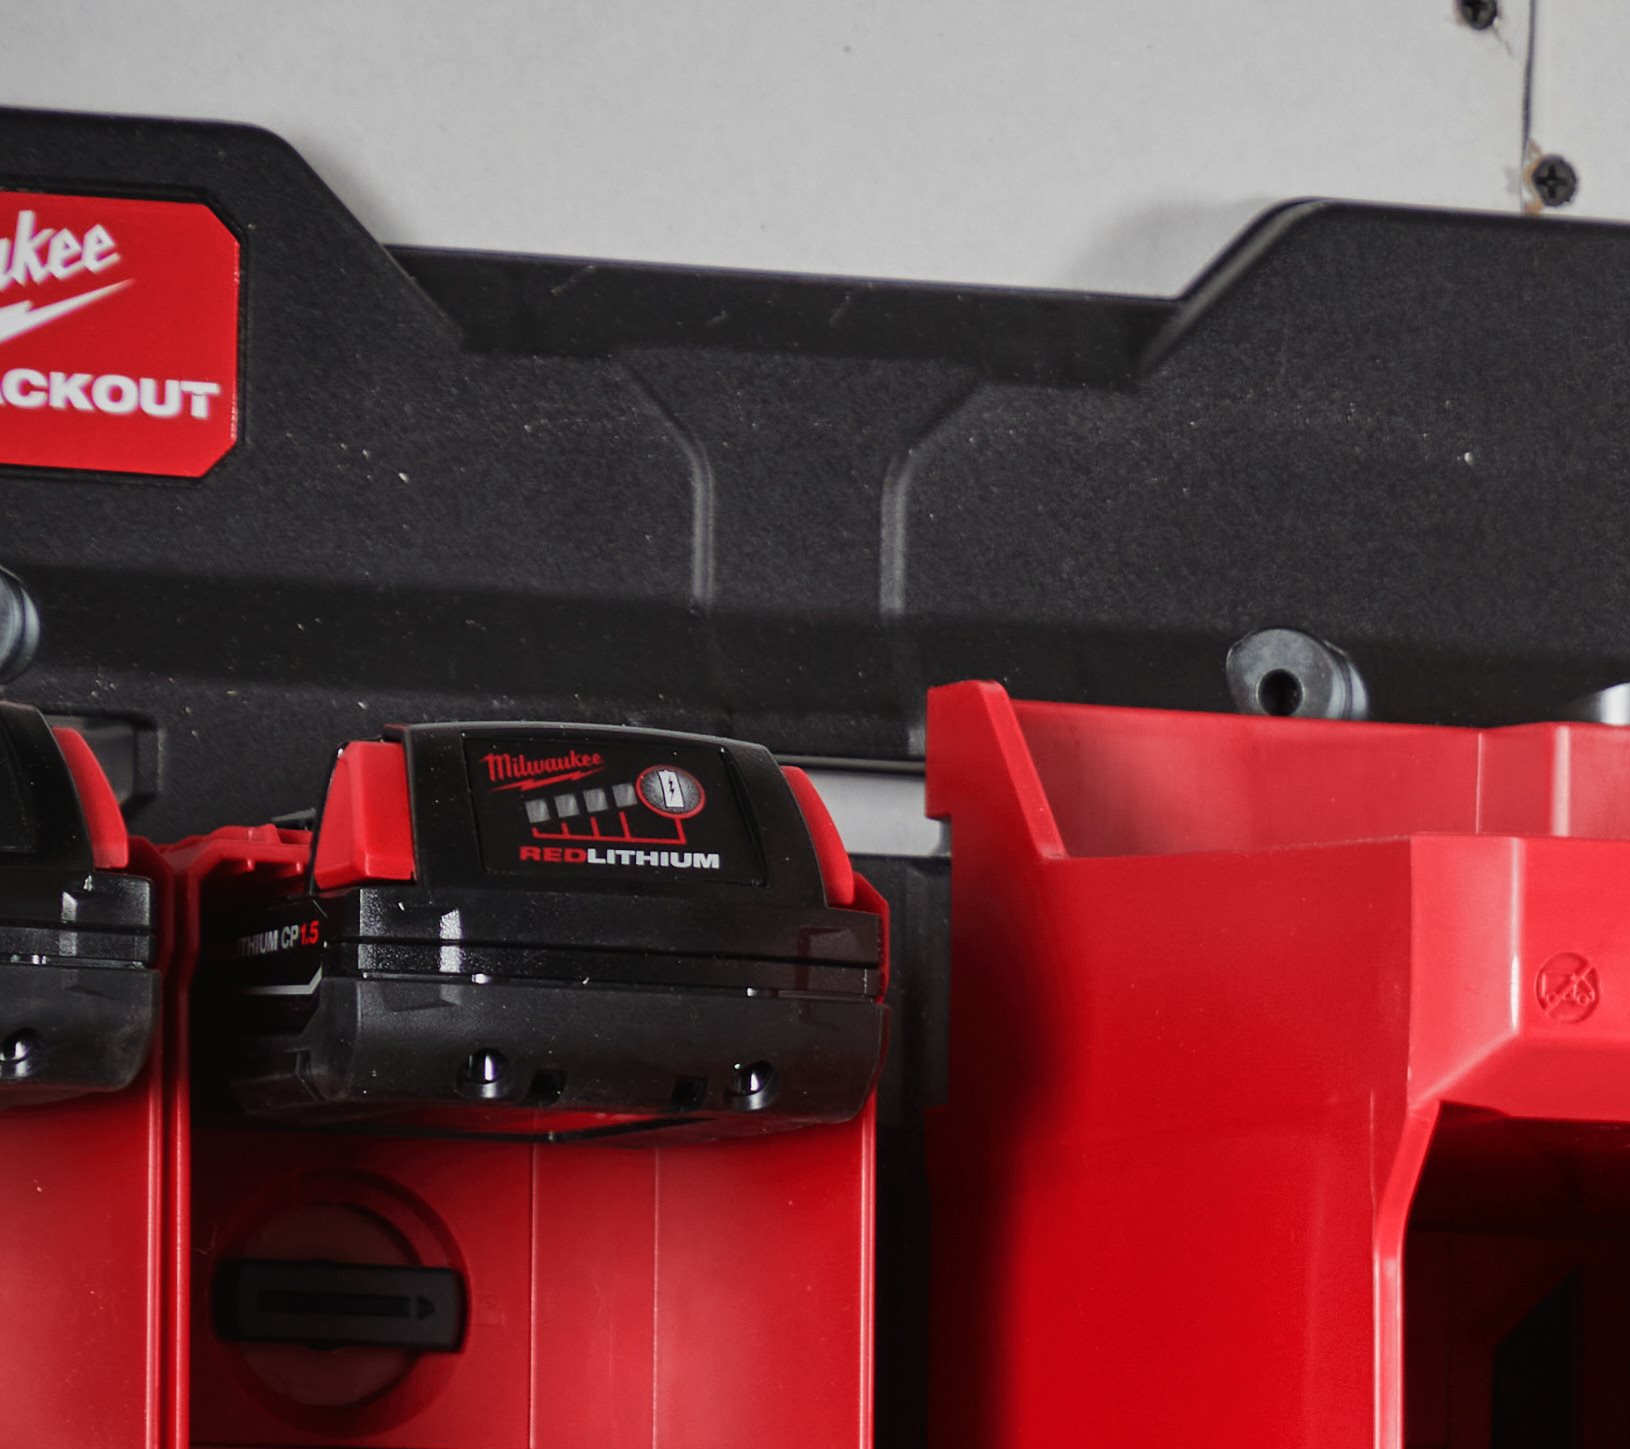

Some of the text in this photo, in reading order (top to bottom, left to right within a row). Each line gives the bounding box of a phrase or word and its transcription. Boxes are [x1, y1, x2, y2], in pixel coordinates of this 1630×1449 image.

[0, 367, 220, 420] CKOUT
[479, 750, 605, 783] Milwaukee
[519, 845, 721, 870] REDLITHIUM
